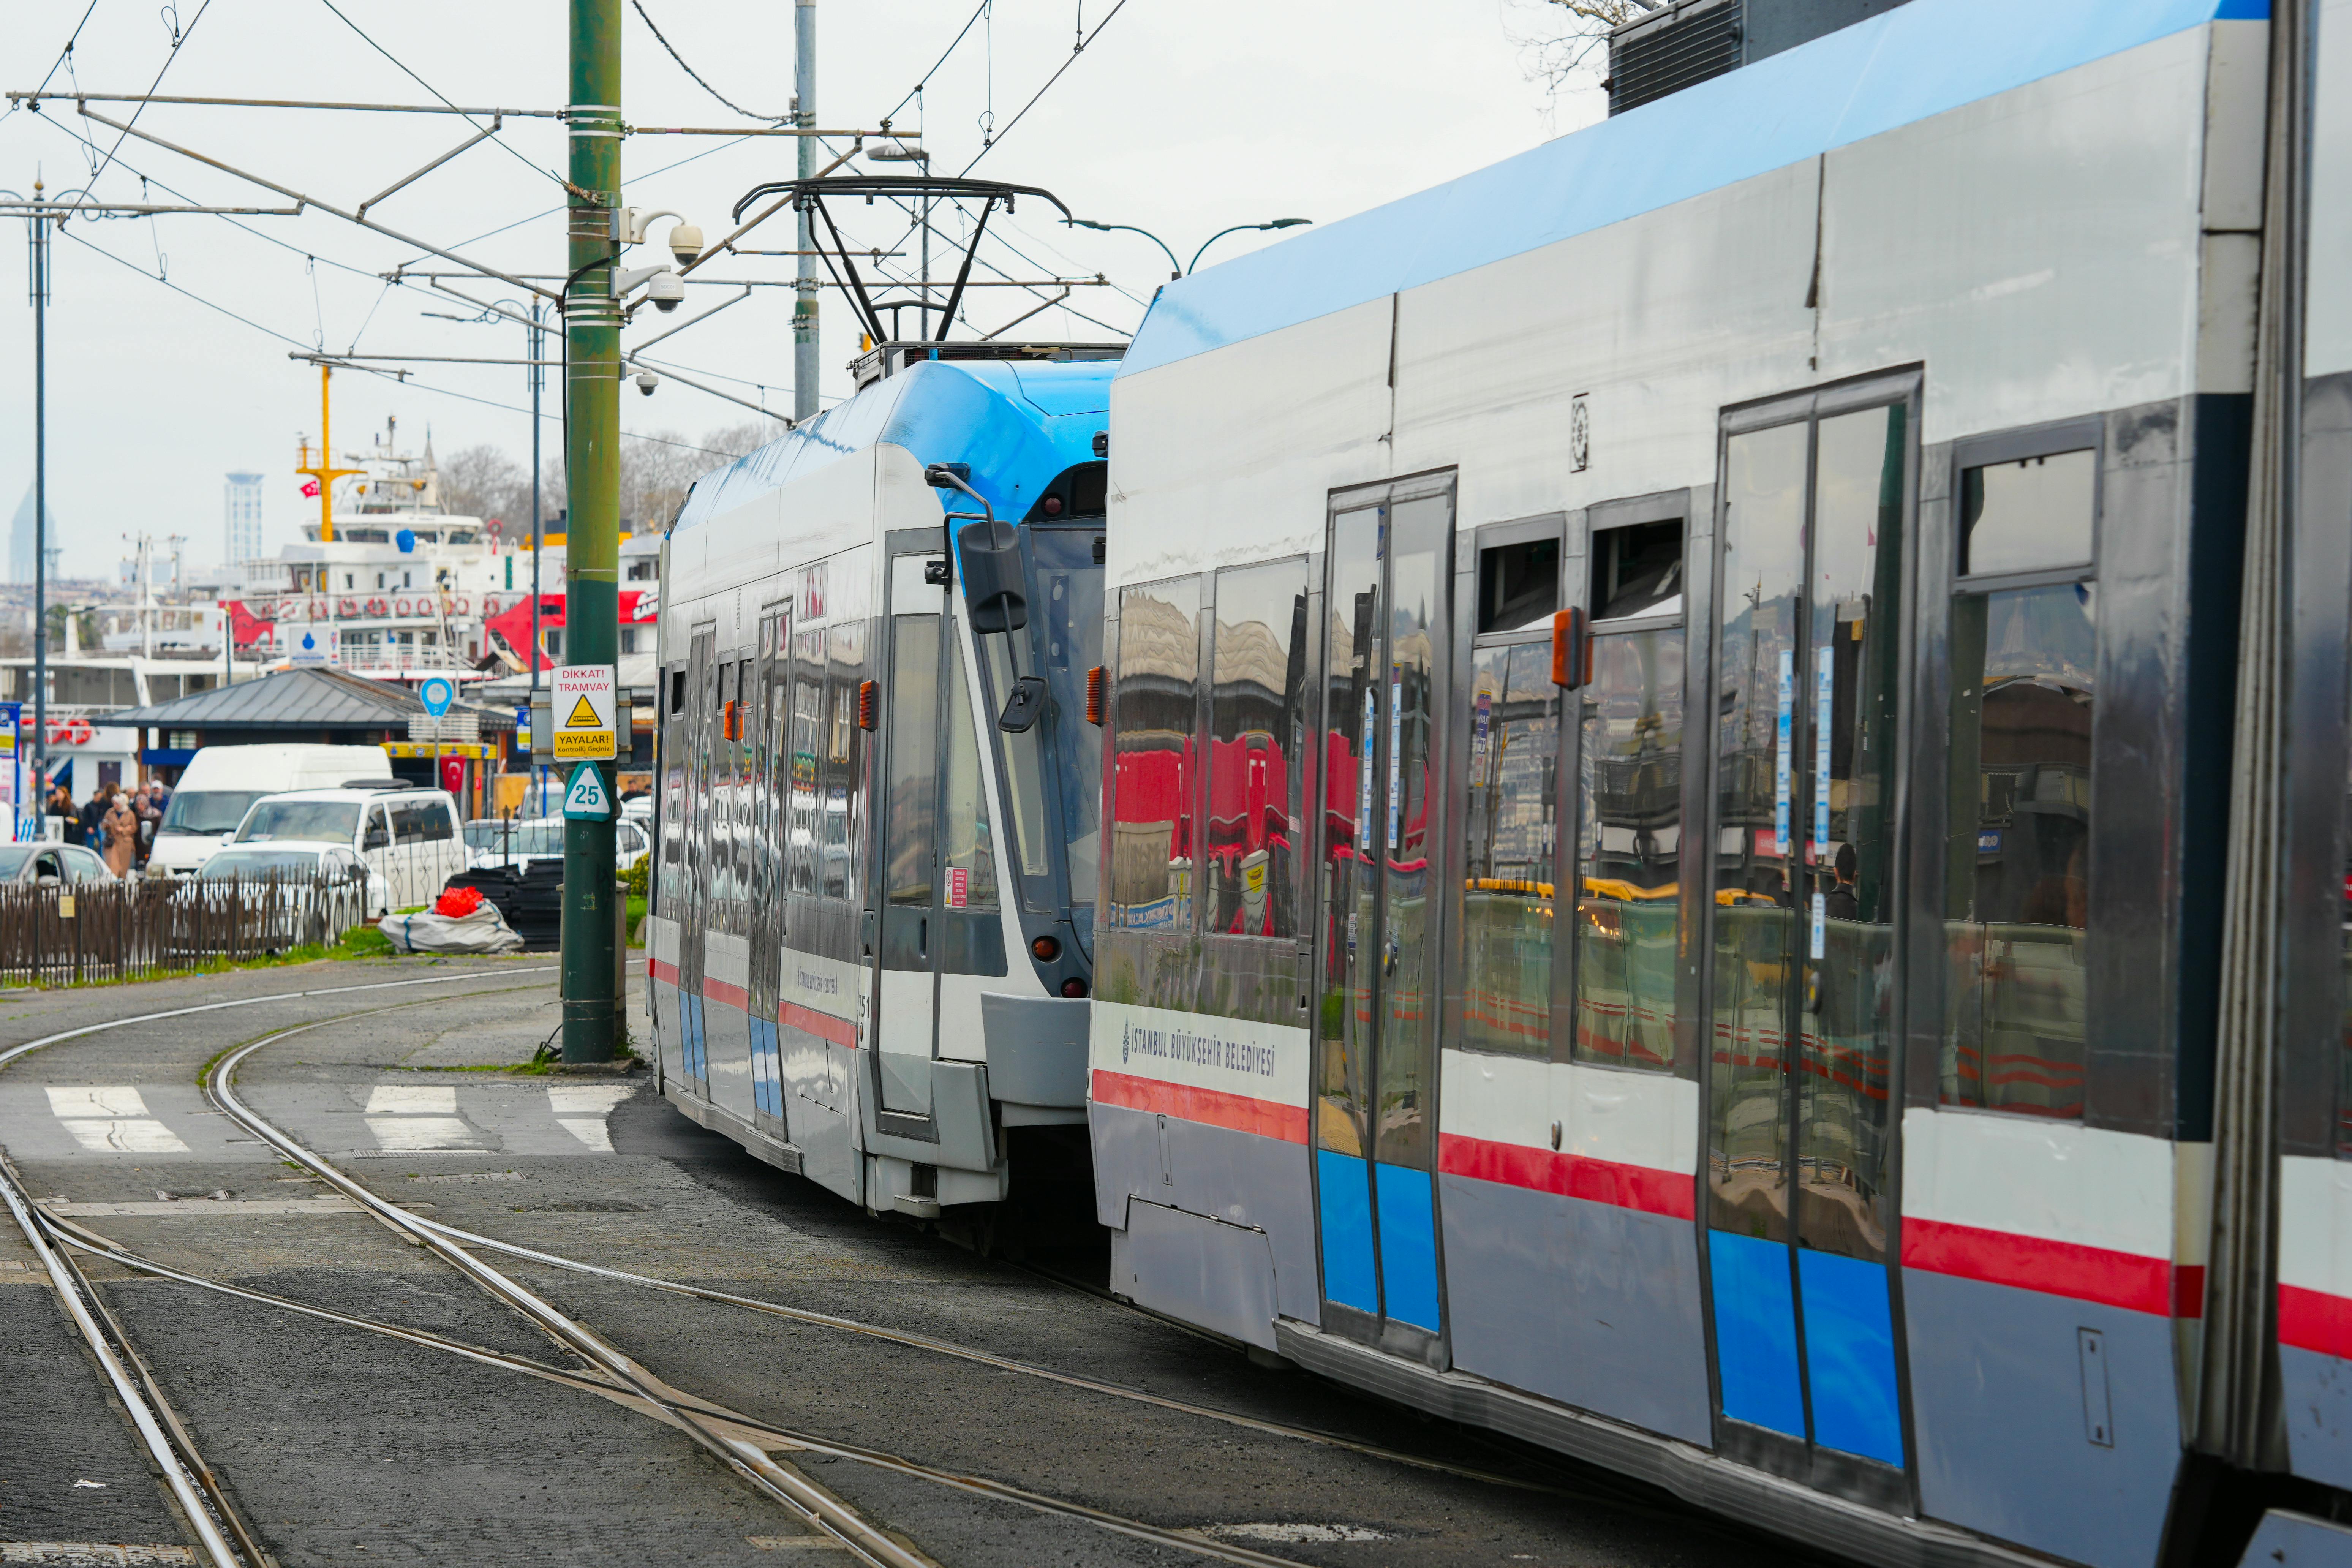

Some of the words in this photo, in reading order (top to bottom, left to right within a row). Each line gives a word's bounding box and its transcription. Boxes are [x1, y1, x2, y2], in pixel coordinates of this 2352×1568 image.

[563, 669, 604, 679] DİKKAT!
[558, 683, 609, 692] TRAMVAY
[559, 735, 609, 744] YAYALAR!
[575, 784, 599, 805] 25
[858, 994, 870, 1018] 751
[1131, 1023, 1167, 1058] İSTANBUL
[1171, 1029, 1221, 1067] BÜYÜKŞEHİR
[1225, 1041, 1276, 1078] BELEDİYESİ
